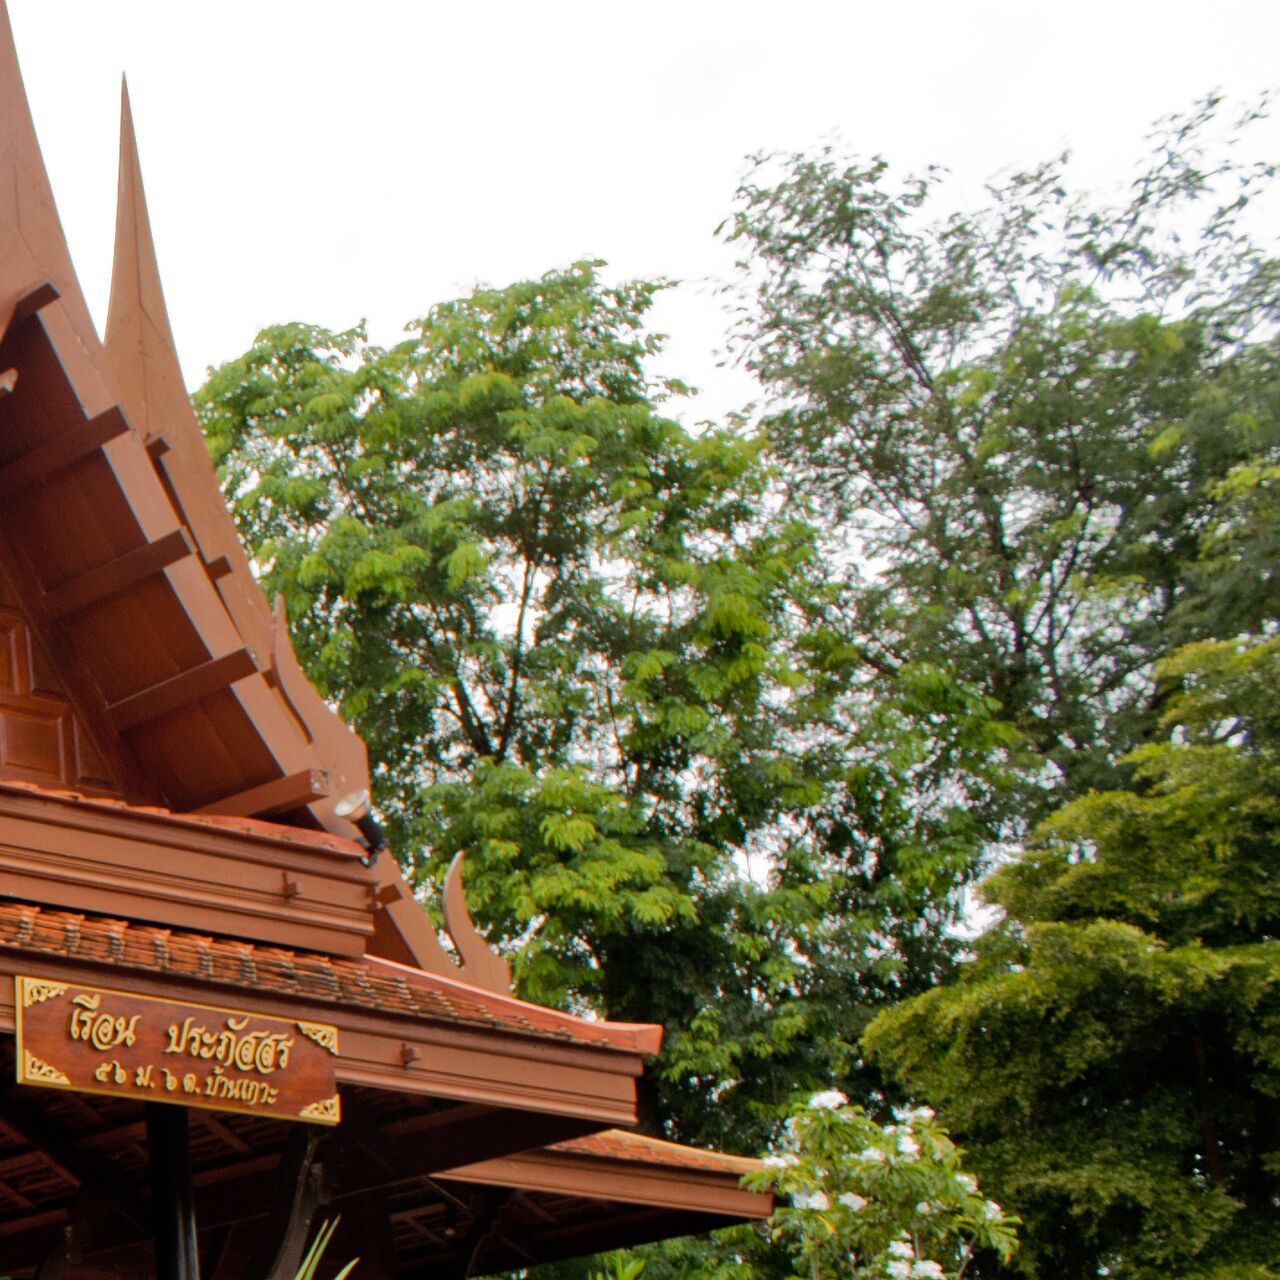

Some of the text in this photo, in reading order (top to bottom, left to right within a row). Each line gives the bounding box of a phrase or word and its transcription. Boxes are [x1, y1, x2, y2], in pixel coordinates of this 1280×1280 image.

[70, 994, 294, 1074] เรือน ประภัสสร
[205, 1065, 279, 1105] บ้านเกาะ
